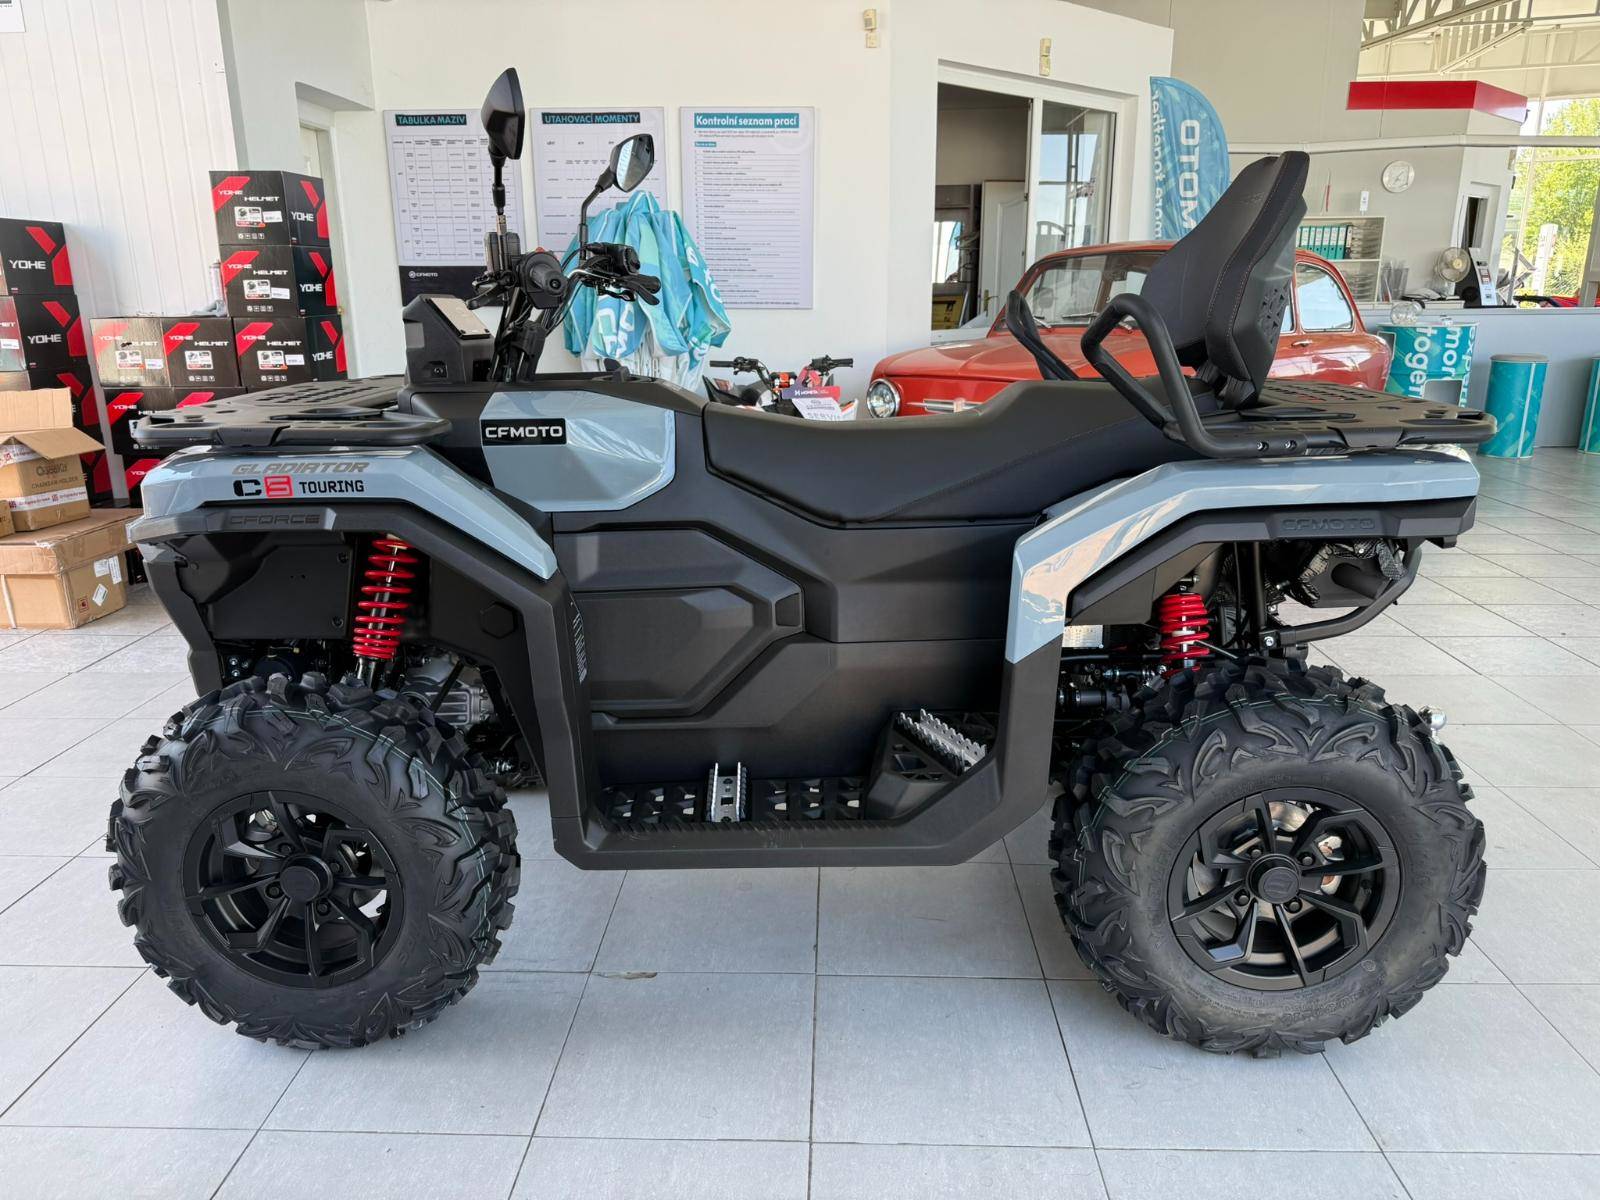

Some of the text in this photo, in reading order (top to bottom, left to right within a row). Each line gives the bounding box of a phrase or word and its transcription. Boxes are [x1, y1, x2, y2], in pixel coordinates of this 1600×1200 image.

[397, 115, 465, 125] TABULKA MAZIV
[594, 114, 639, 123] MOMENTY
[696, 115, 797, 127] Kontrolní seznam prací
[291, 211, 314, 222] YOHE
[9, 259, 46, 270] YOHE
[300, 283, 323, 293] YOHE
[27, 333, 62, 345] YOHE
[312, 351, 333, 361] YOHE
[1442, 327, 1462, 380] mor
[1405, 327, 1438, 399] toget
[484, 425, 563, 439] CFMOTO
[232, 462, 370, 475] GLADIATOR
[299, 480, 365, 494] TOURING
[229, 514, 321, 525] CFORCE
[1282, 518, 1376, 531] CFMOTO
